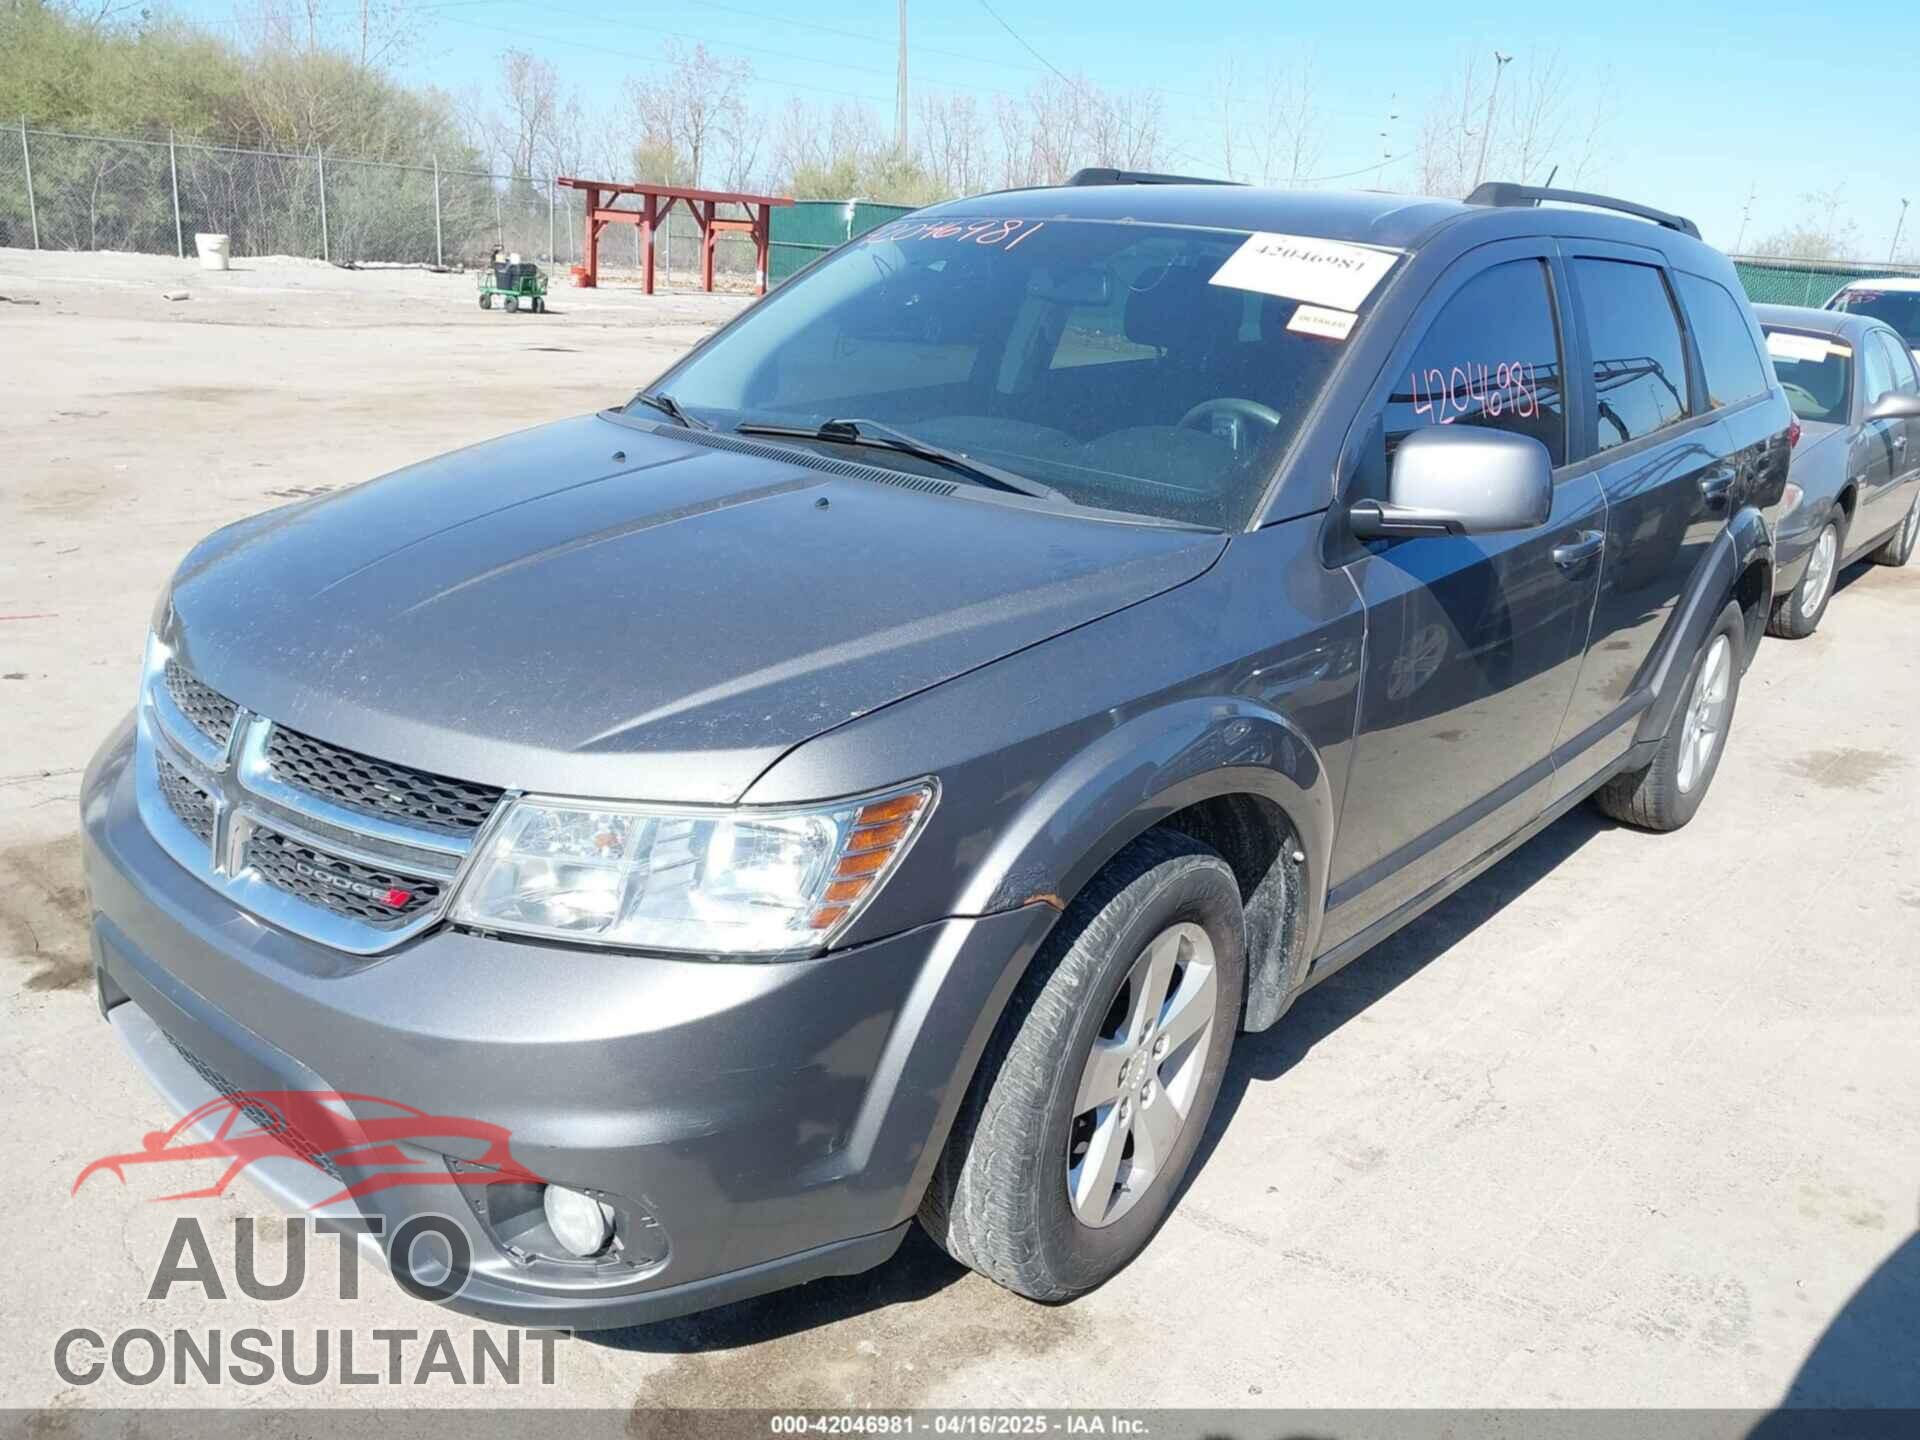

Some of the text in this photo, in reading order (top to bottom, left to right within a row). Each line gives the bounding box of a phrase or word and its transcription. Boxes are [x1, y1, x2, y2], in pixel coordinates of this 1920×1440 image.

[1256, 245, 1366, 271] 42046981
[1412, 361, 1541, 425] 42046981
[297, 861, 390, 900] DODGE
